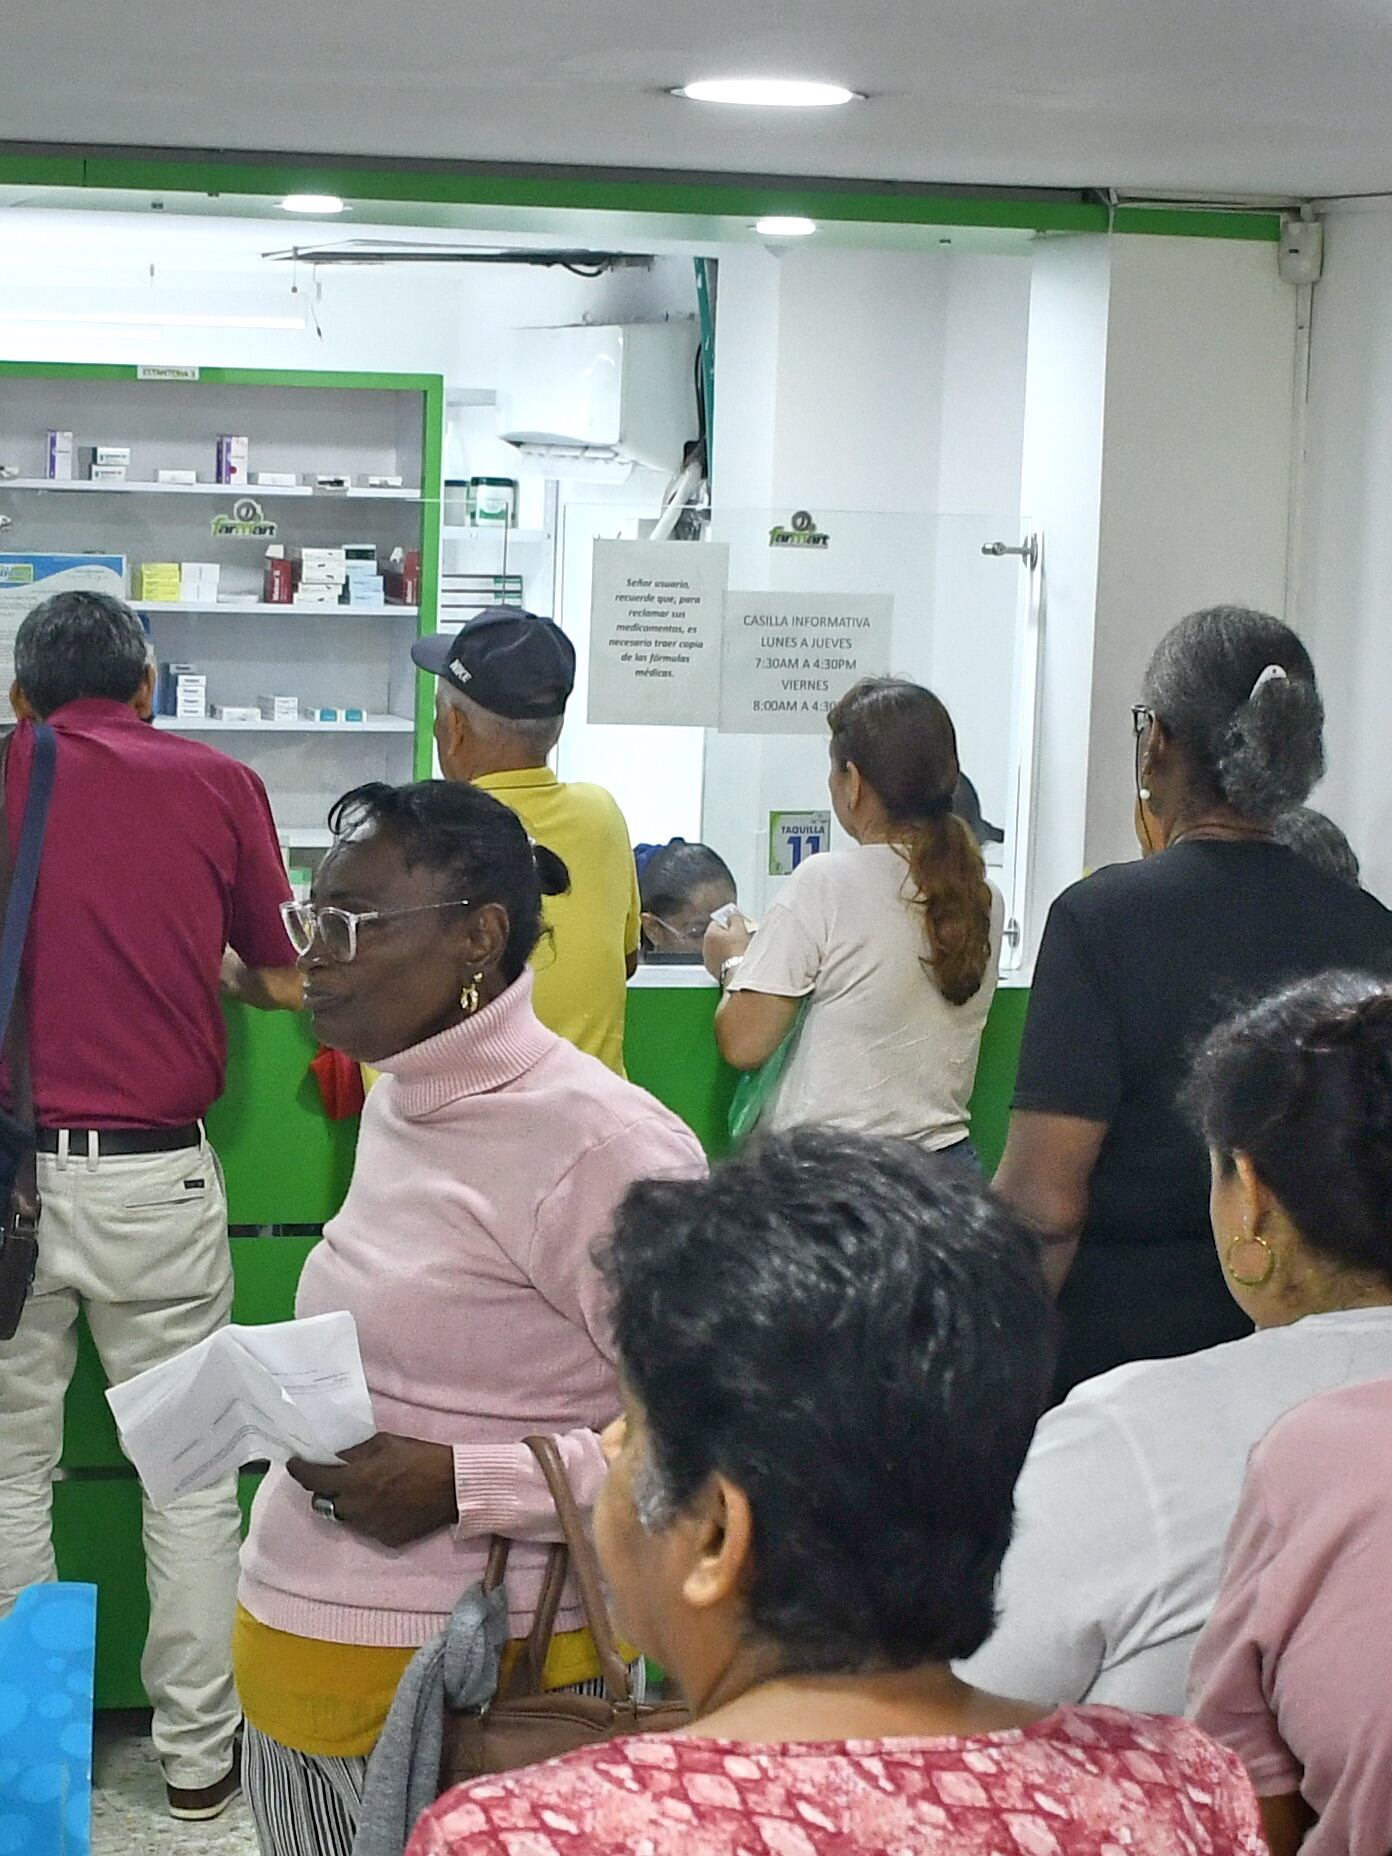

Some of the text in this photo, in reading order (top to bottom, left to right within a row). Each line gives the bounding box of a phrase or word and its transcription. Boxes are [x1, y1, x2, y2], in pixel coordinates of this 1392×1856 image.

[627, 578, 690, 589] Señor usuario,
[615, 594, 701, 605] recuerde que, para
[628, 609, 669, 617] reclamar
[743, 615, 870, 628] CASILLA INFORMATIVA
[616, 623, 685, 633] medicamentos,
[609, 639, 703, 649] necesario traer copia
[761, 637, 852, 649] LUNES A JUEVES
[621, 653, 690, 664] de las fórmulas
[755, 658, 857, 670] 7:30AM A 4:30PM
[635, 667, 674, 677] médicas.
[781, 680, 829, 691] VIERNES
[753, 700, 797, 711] 8:00AM
[801, 701, 809, 711] A
[781, 825, 825, 834] TAQUILLA
[787, 835, 820, 871] 11
